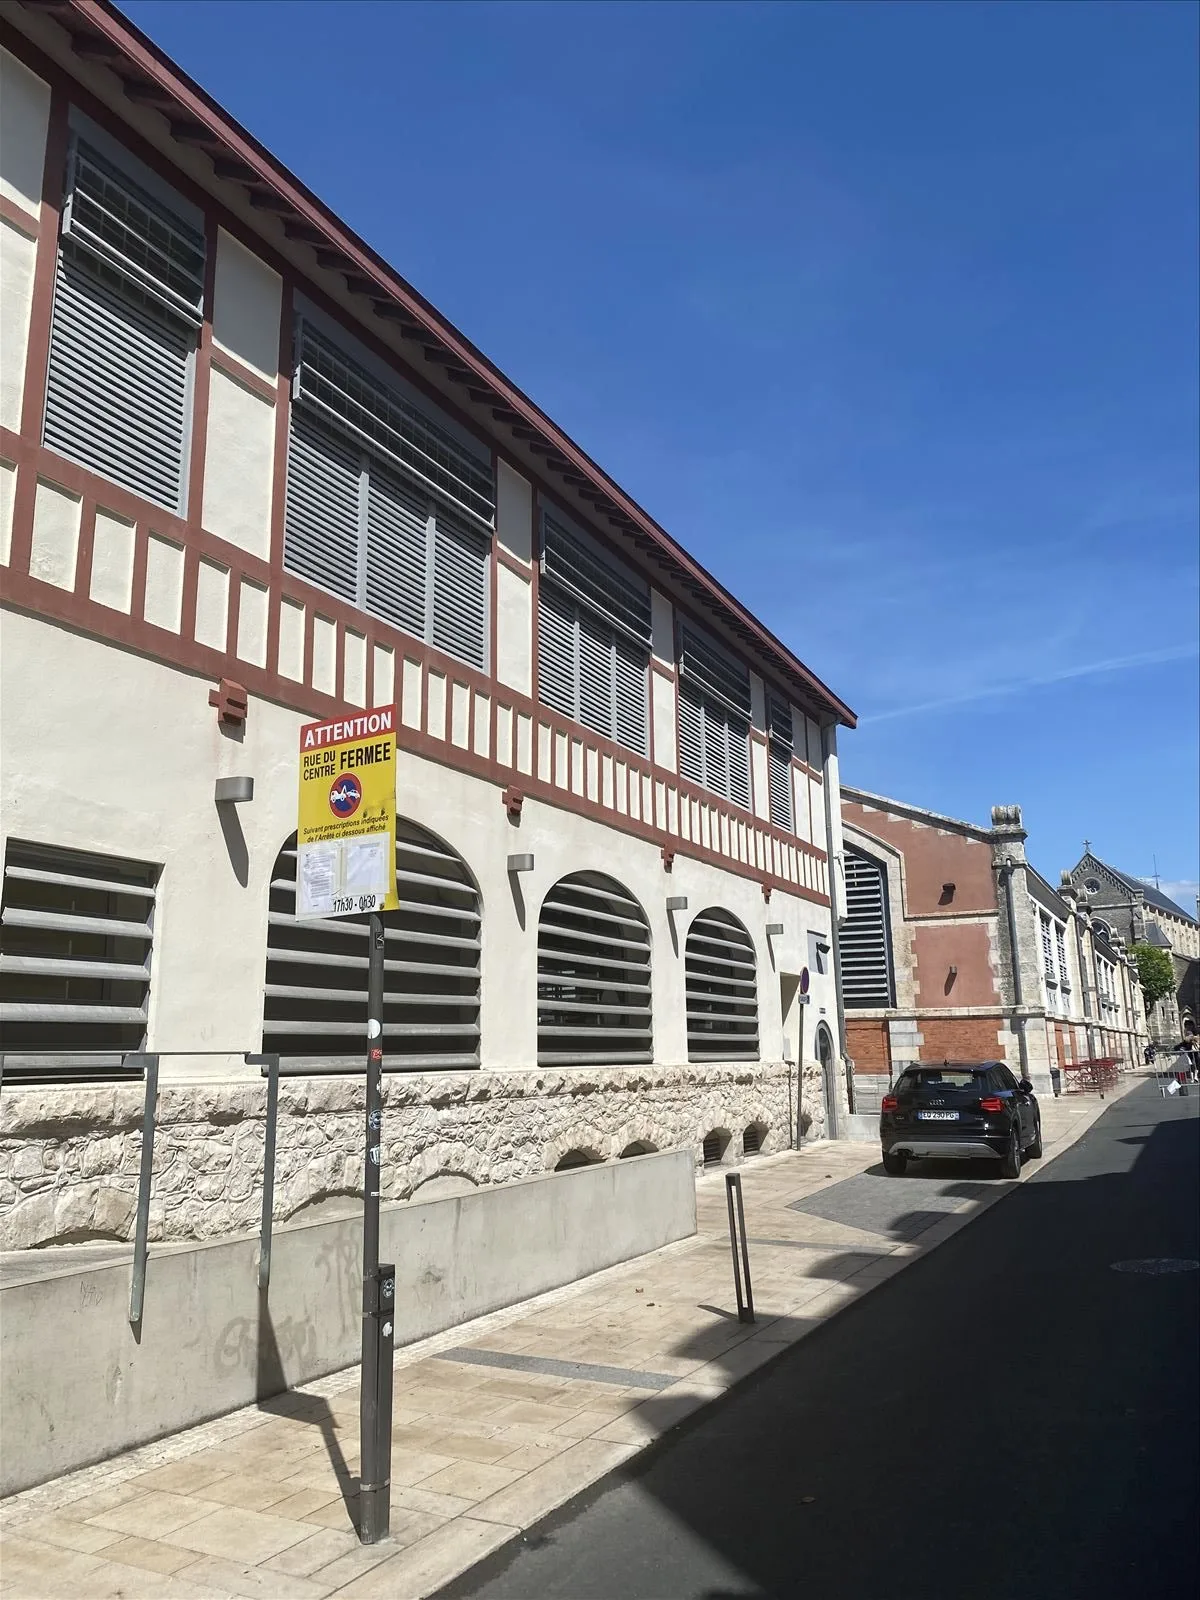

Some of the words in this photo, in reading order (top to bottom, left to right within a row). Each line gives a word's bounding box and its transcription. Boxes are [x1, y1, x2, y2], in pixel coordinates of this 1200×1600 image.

[305, 711, 392, 748] ATTENTION
[303, 753, 321, 768] RUE
[324, 750, 336, 764] DU
[340, 742, 391, 770] FERMEE
[303, 764, 336, 781] CENTRE
[303, 825, 324, 835] Suivant
[324, 819, 360, 832] prescriptions
[341, 828, 365, 837] dessous
[365, 823, 386, 833] affiché
[333, 897, 354, 912] 17h30
